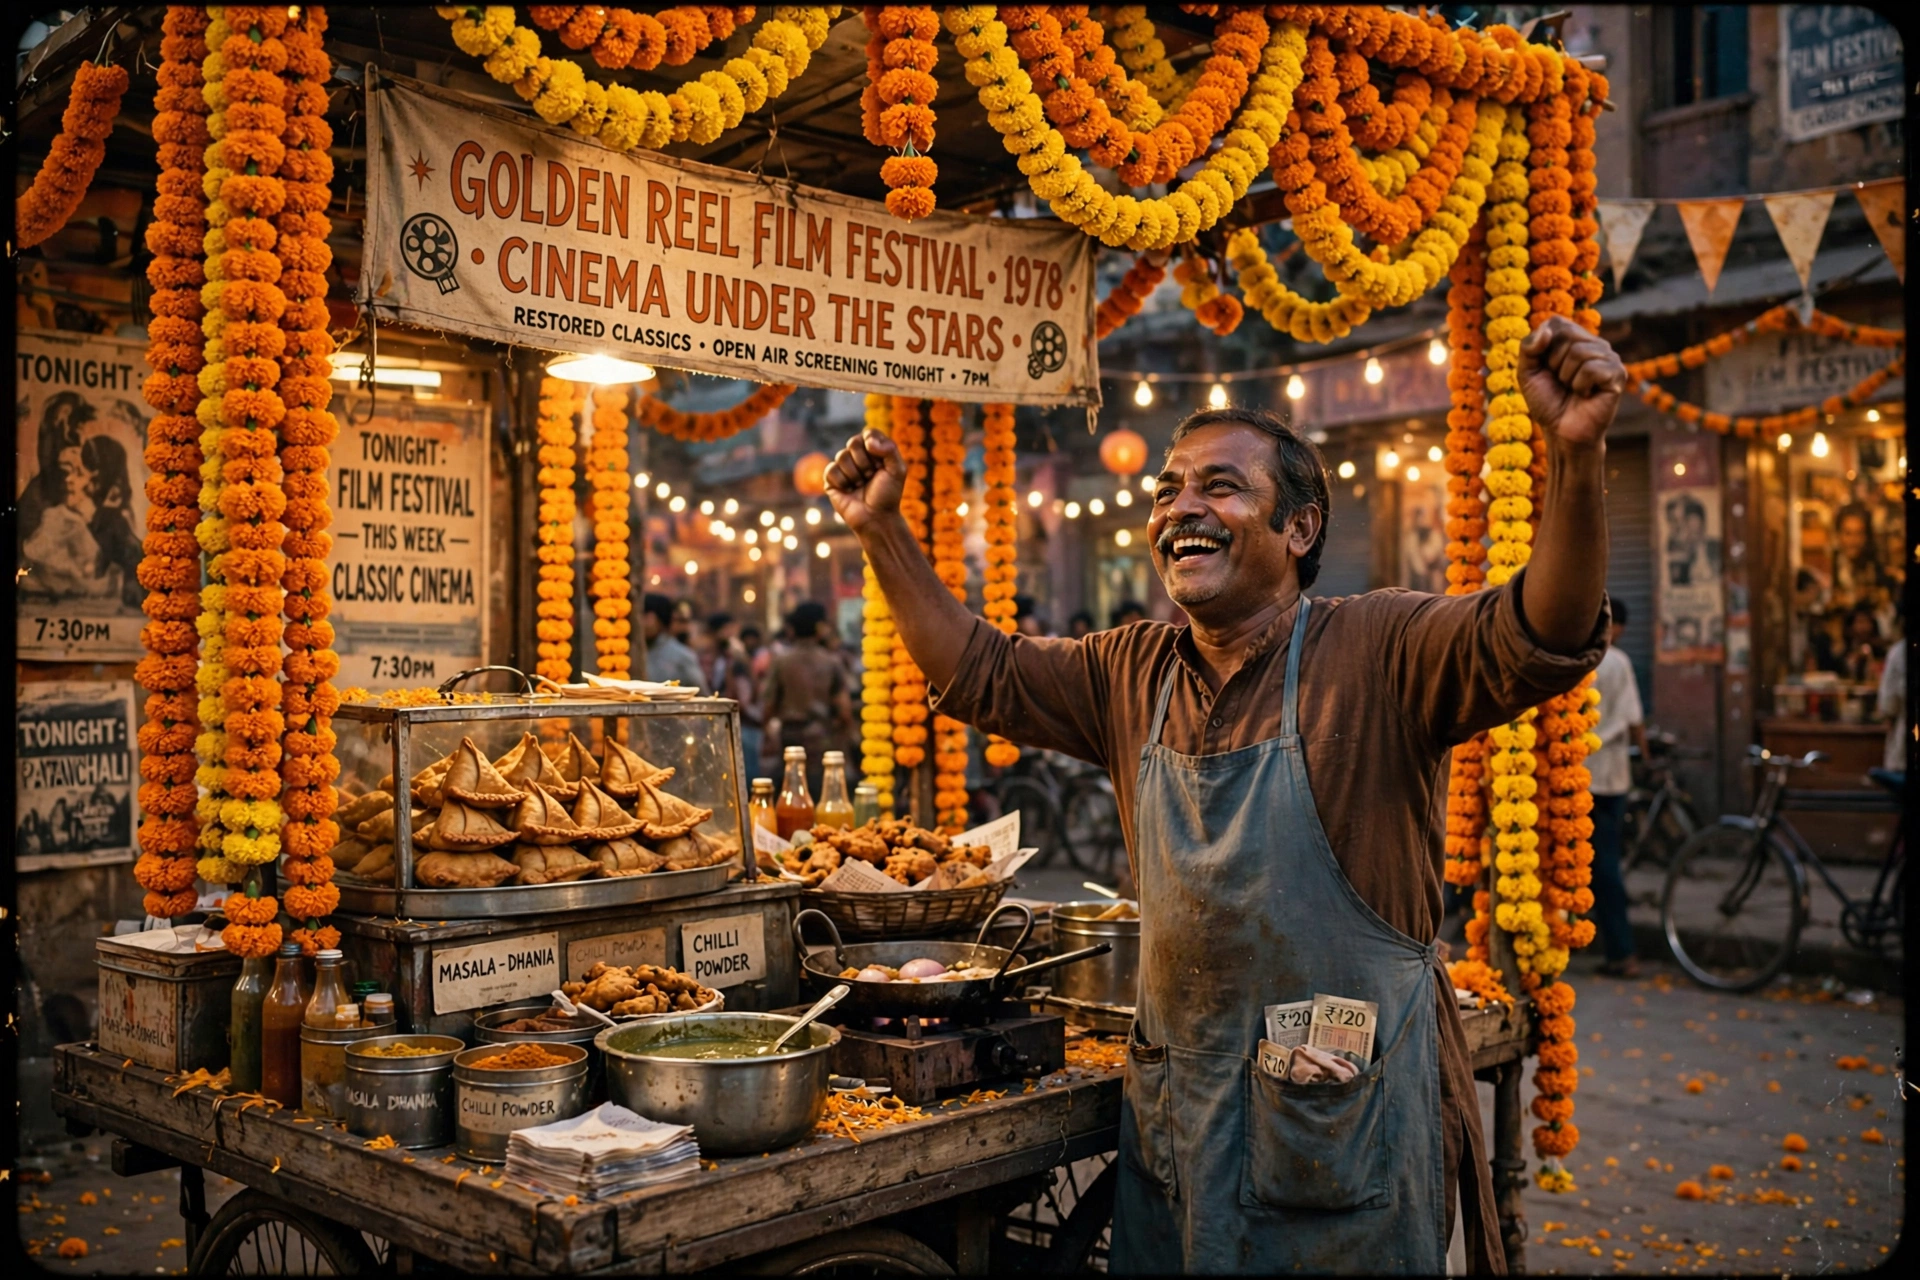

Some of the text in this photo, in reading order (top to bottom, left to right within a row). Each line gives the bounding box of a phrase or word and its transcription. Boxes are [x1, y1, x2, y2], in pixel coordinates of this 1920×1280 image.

[450, 140, 1063, 311] GOLDEN REEL FILM FESTIVAL 1978
[497, 236, 1004, 362] CINEMA UNDER THE STARS
[513, 306, 990, 387] RESTORED CLASSICS OPEN AIR SCREENING TONIGHT 7PM
[17, 353, 143, 390] TONIGHT:
[359, 431, 447, 466] TONIGHT:
[337, 468, 475, 518] FILM FESTIVAL
[362, 523, 447, 553] THIS WEEK
[333, 562, 475, 605] CLASSIC CINEMA
[34, 618, 110, 642] 7:30PM
[370, 655, 436, 680] 7:30PM
[19, 717, 125, 748] TONIGHT:
[693, 929, 739, 953] CHILLI
[695, 953, 751, 979] POWDER
[462, 1097, 556, 1118] CHILLI POWDER
